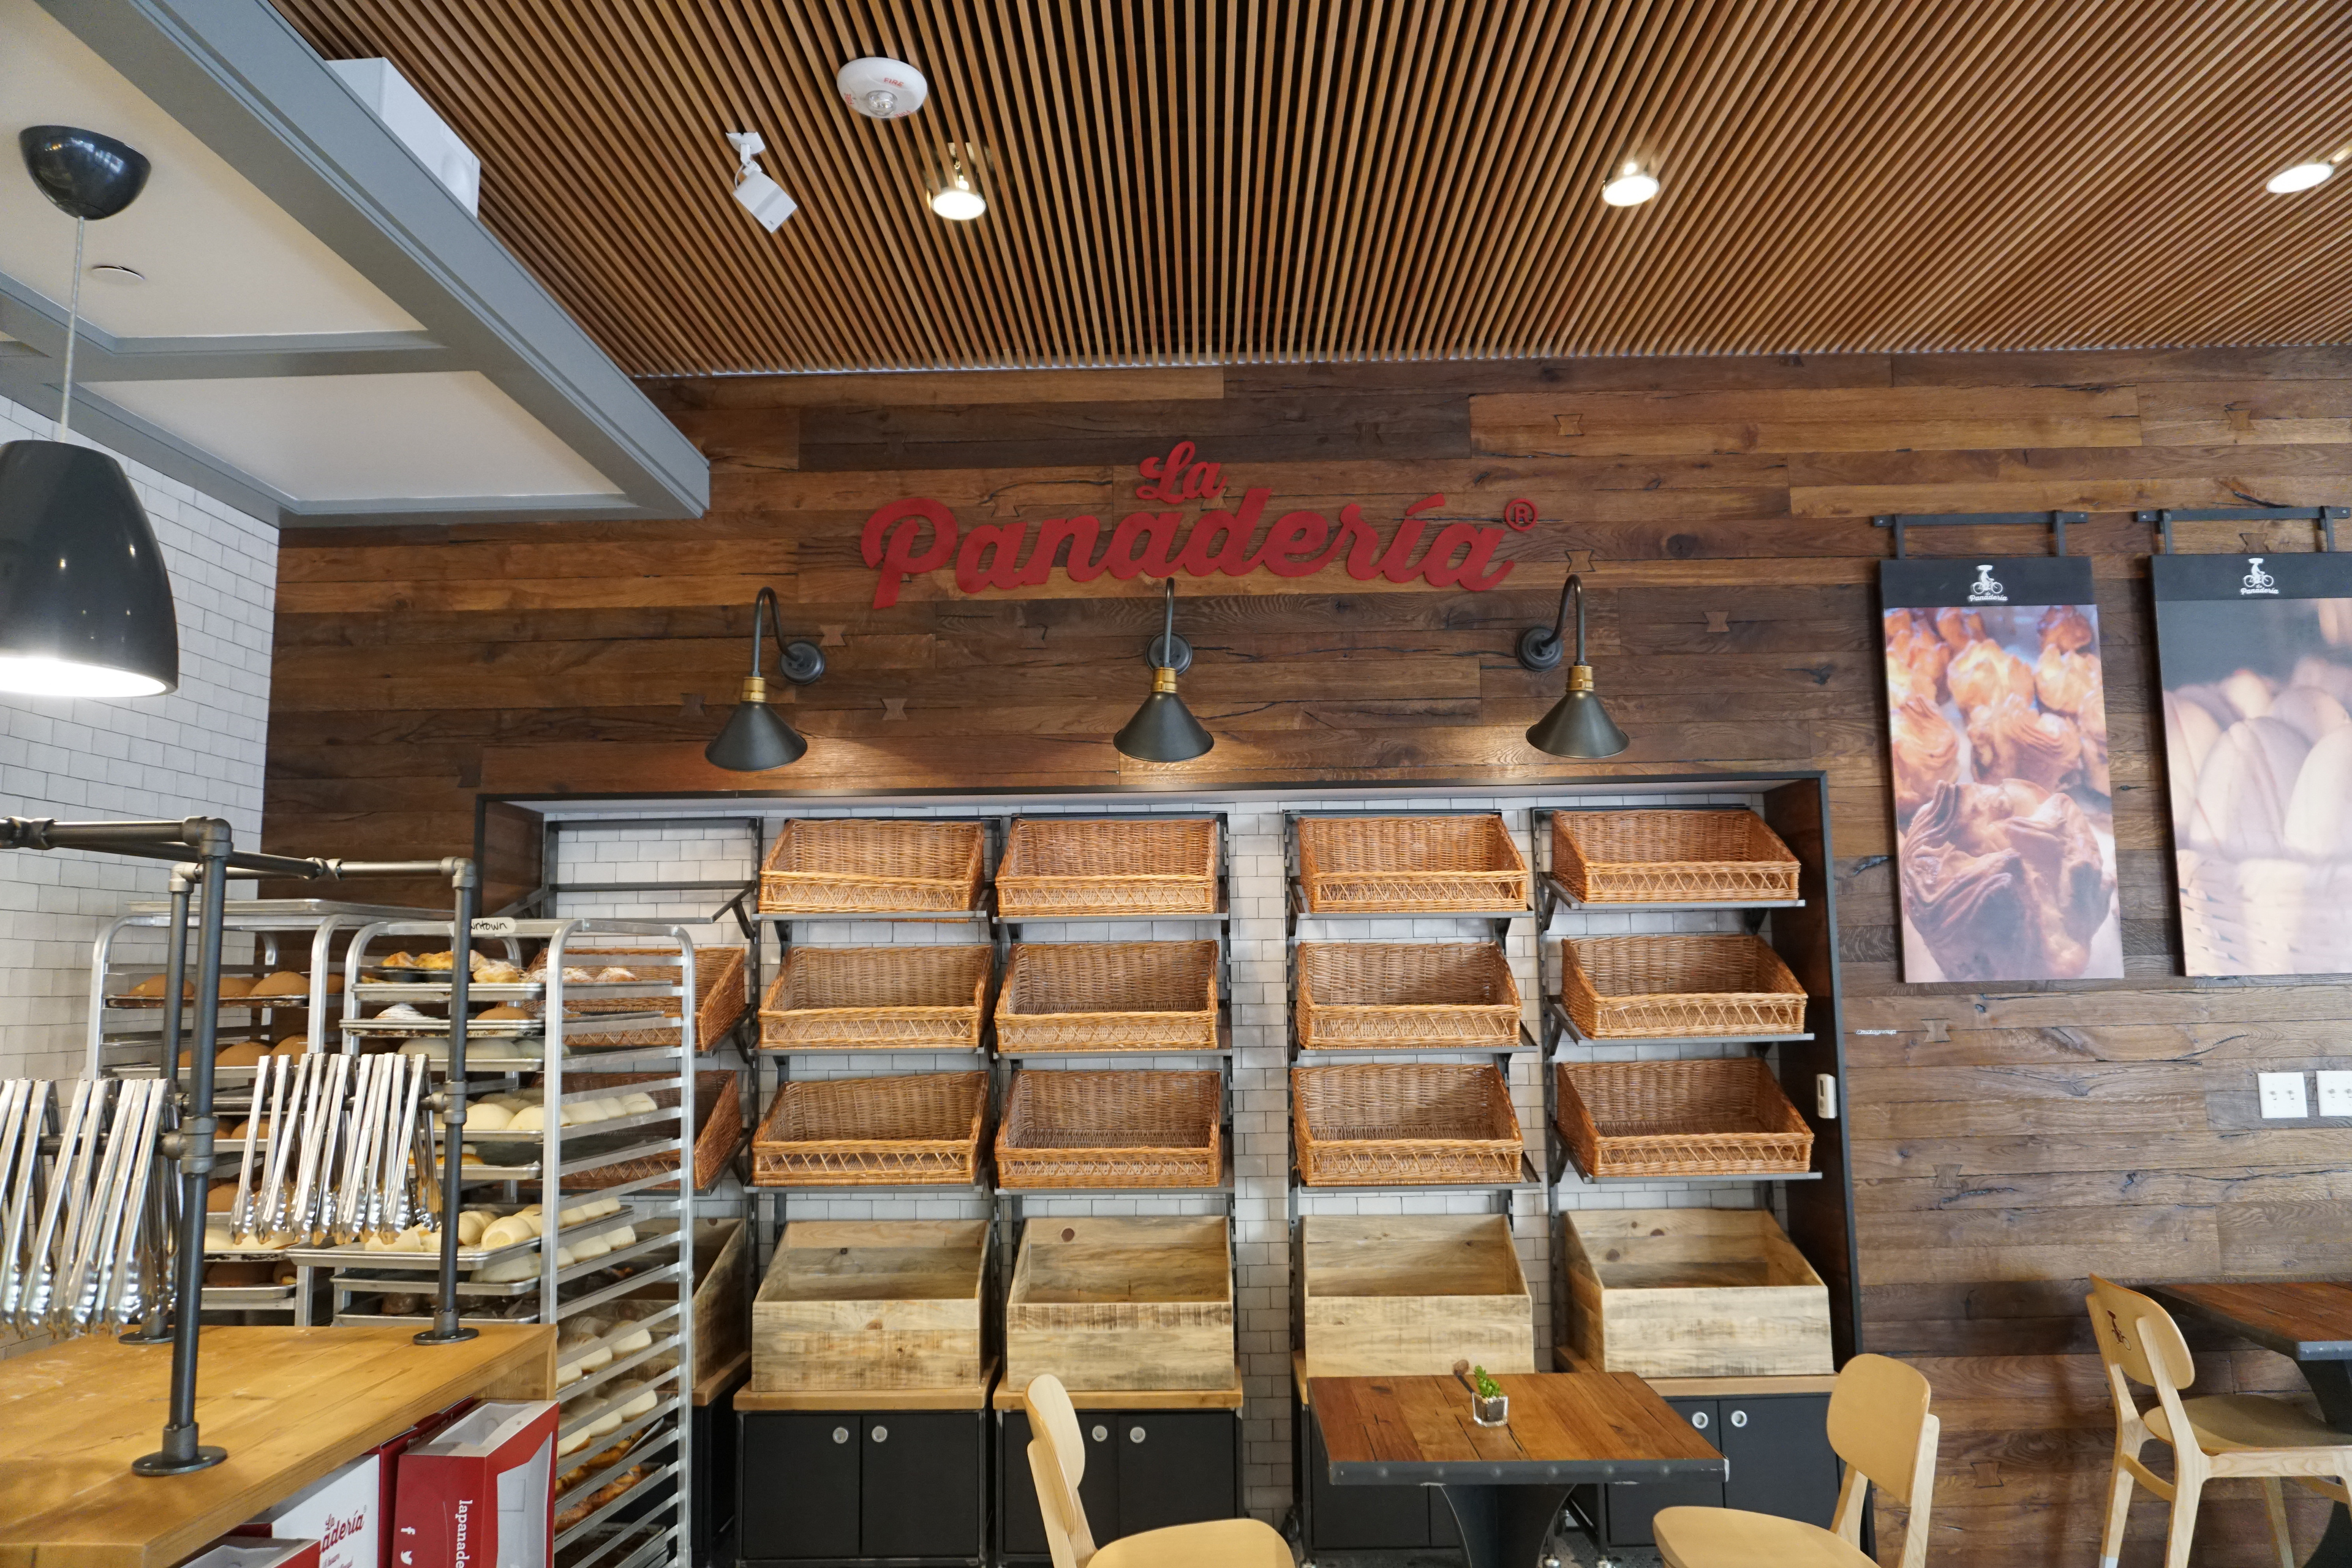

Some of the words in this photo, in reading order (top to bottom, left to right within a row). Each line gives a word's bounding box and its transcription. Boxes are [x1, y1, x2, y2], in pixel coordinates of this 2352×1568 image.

[883, 77, 904, 87] FIRE
[1136, 441, 1227, 505] La
[861, 488, 1516, 609] Panadería
[320, 1509, 364, 1553] adería
